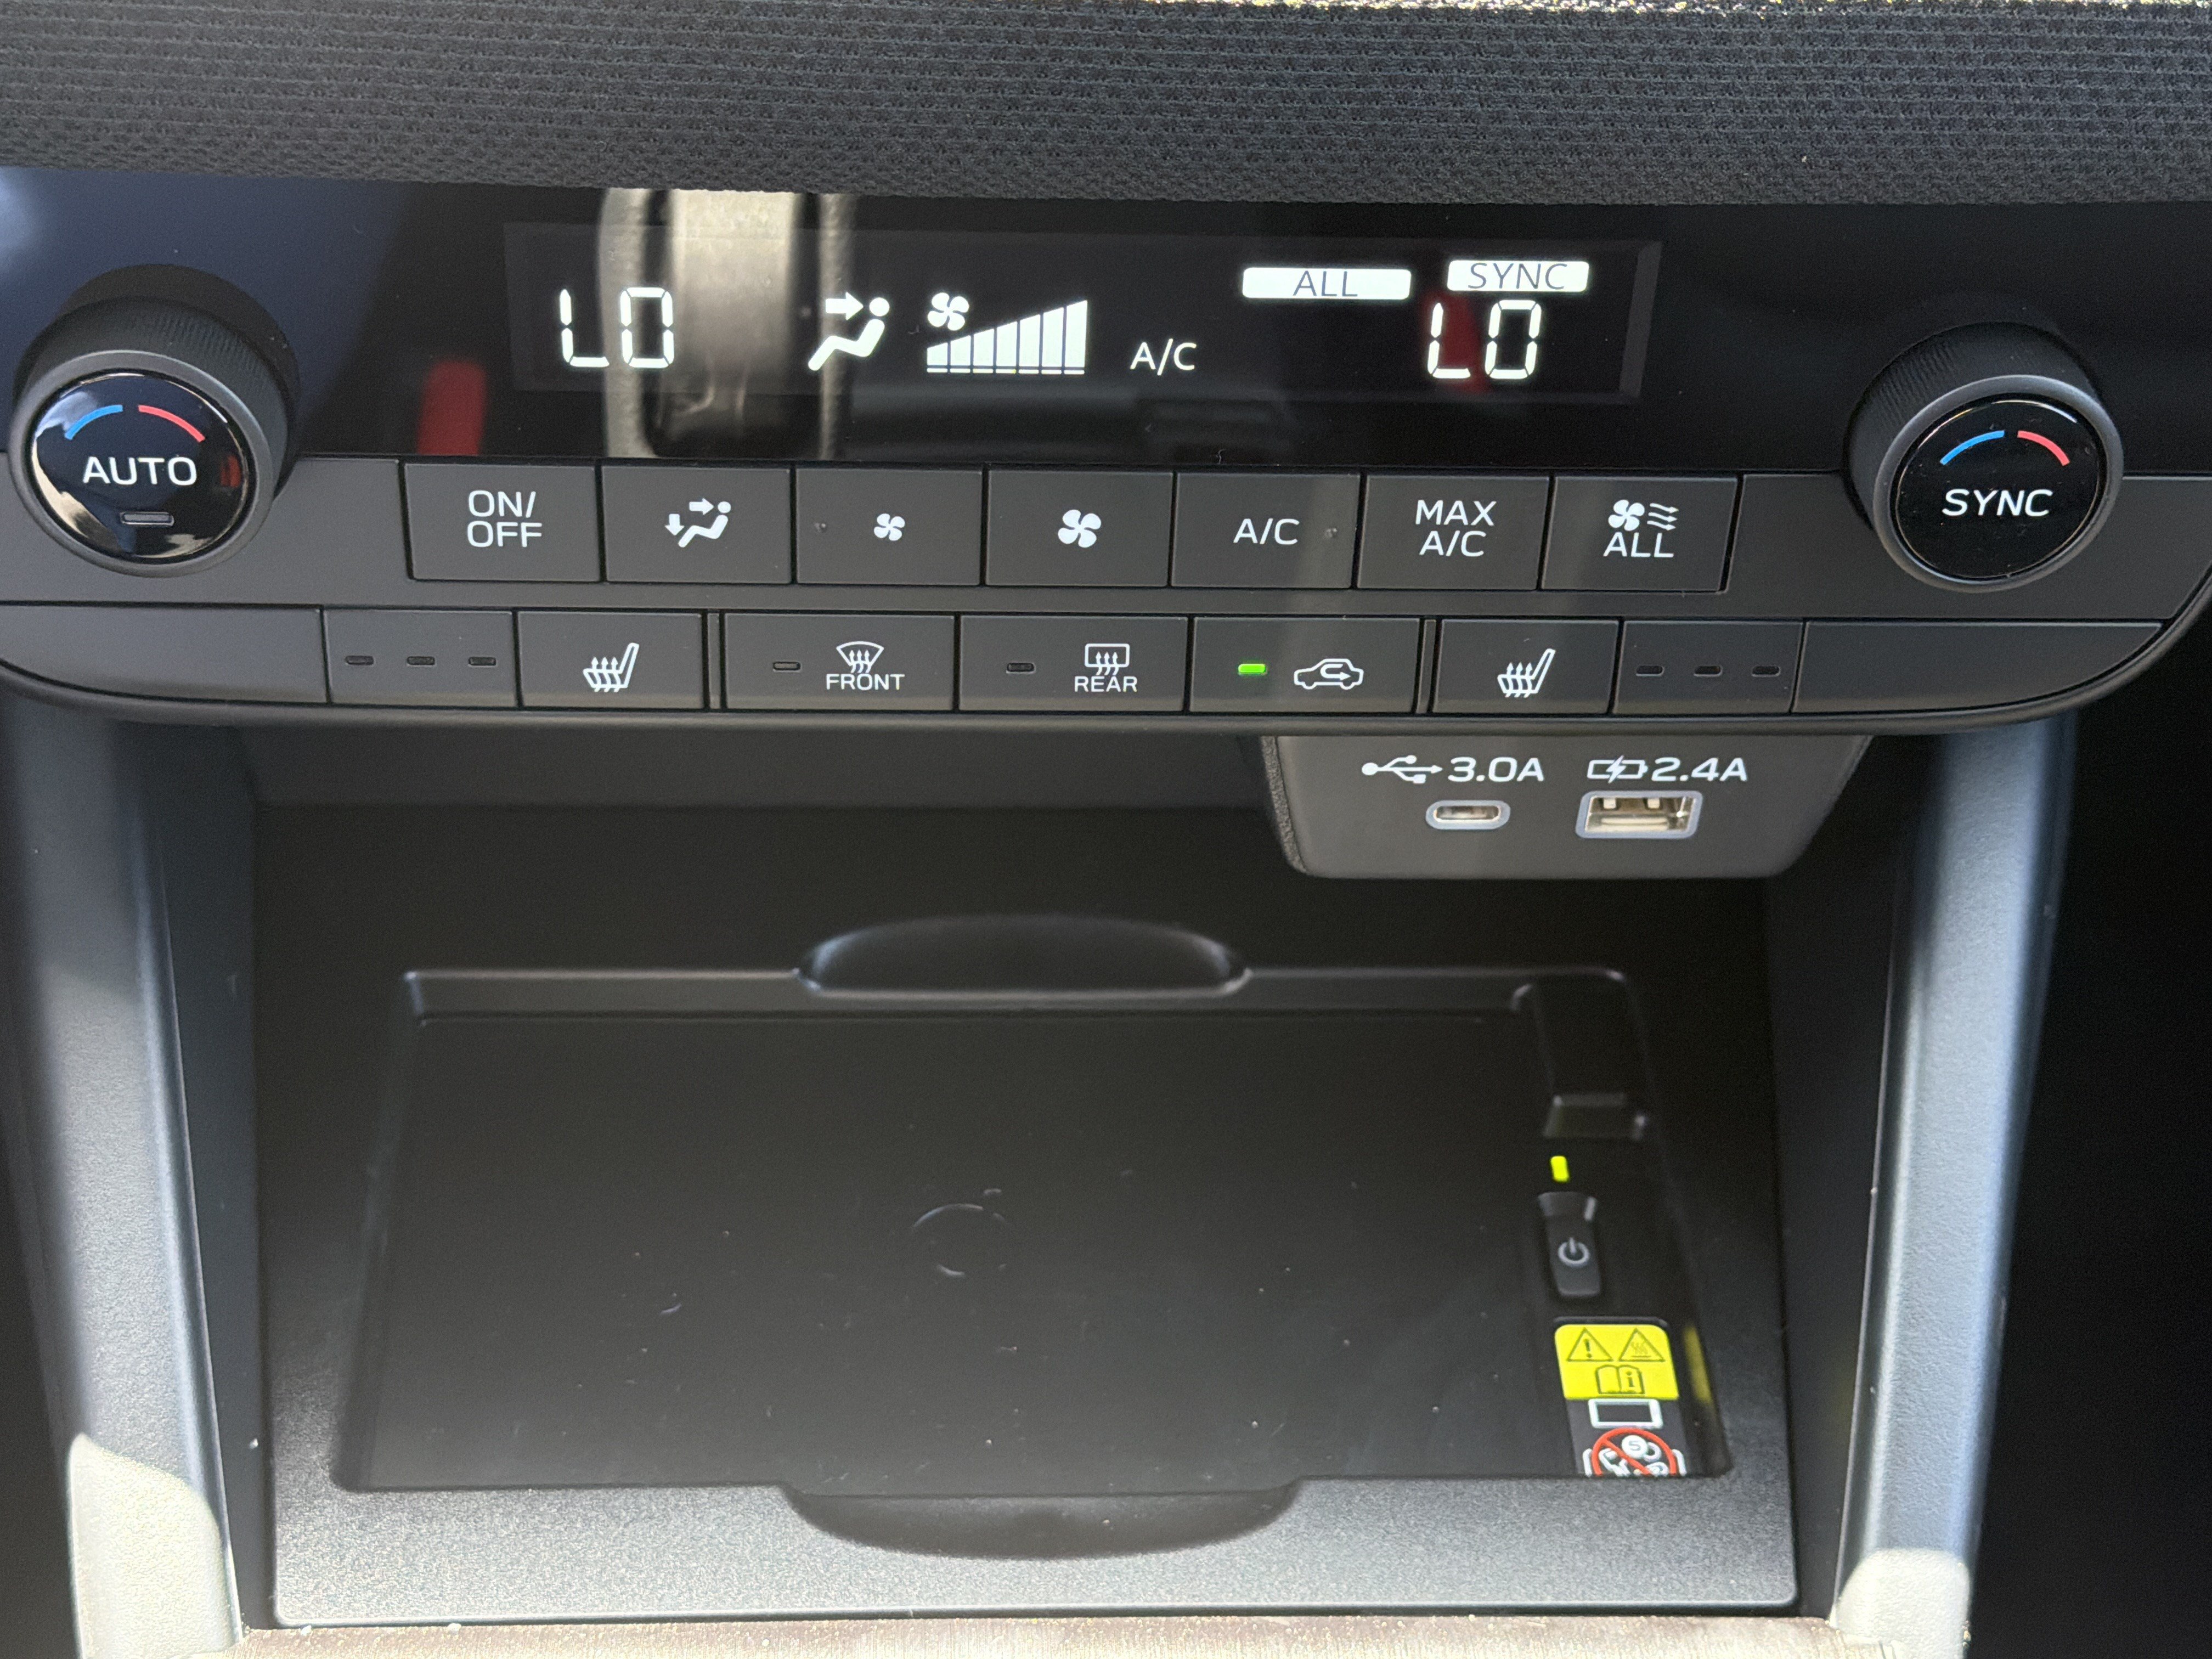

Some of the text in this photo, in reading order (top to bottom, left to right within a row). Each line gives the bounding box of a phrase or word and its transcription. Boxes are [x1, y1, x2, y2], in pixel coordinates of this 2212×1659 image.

[1293, 270, 1358, 297] ALL
[1468, 262, 1568, 290] SYNC
[559, 286, 675, 369] LO
[1427, 299, 1542, 380] LO
[1130, 337, 1198, 376] A/C
[83, 456, 198, 486] AUTO
[467, 489, 537, 519] ON/
[1415, 499, 1498, 527] MAX
[1942, 488, 2053, 517] SYNC
[466, 520, 543, 548] OFF
[1233, 517, 1300, 545] A/C
[1419, 529, 1487, 557] A/C
[1603, 531, 1674, 558] ALL
[826, 673, 905, 691] FRONT
[1074, 675, 1138, 693] REAR
[1447, 757, 1545, 782] 3.0A
[1651, 757, 1748, 782] 2.4A
